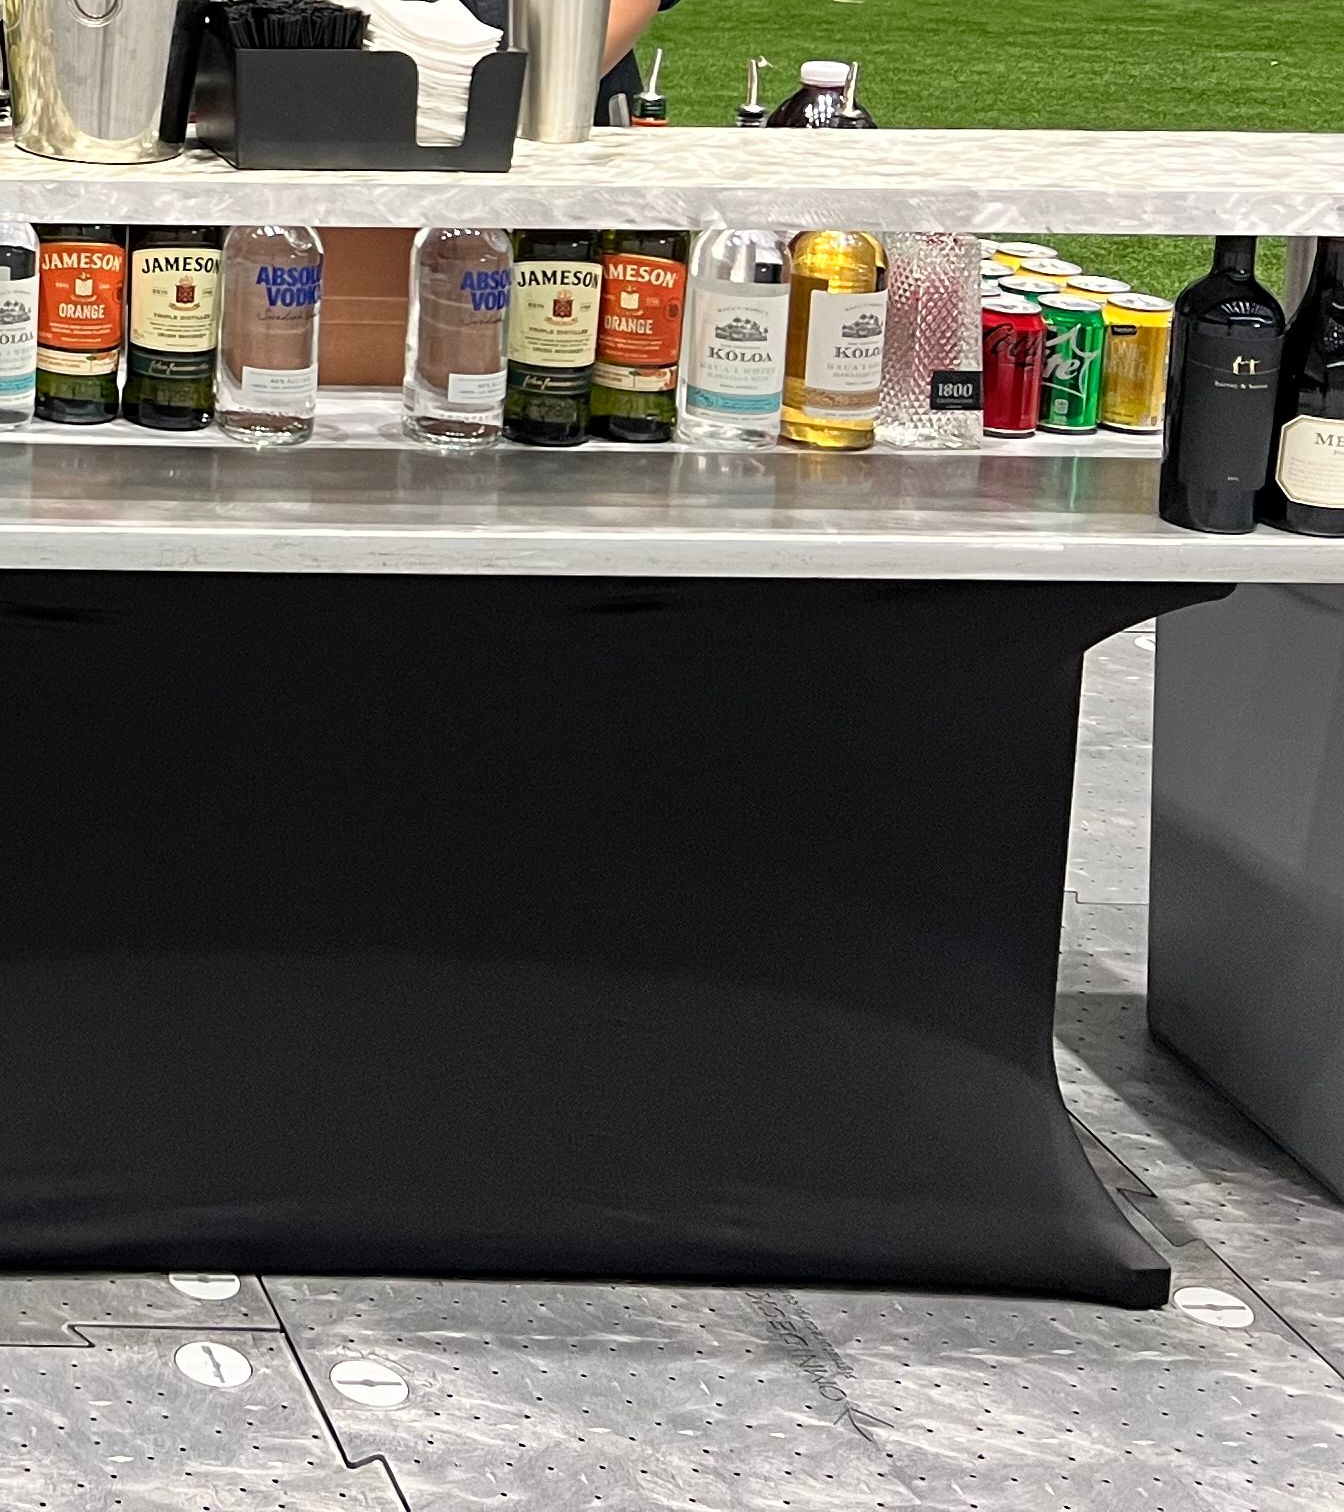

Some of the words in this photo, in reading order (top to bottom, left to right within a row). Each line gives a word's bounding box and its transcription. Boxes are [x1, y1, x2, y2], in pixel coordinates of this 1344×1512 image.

[41, 252, 123, 273] JAMESON
[141, 256, 220, 274] JAMESON
[517, 269, 600, 290] JAMESON
[58, 303, 105, 319] ORANGE
[604, 315, 654, 335] ORANGE
[707, 345, 773, 363] KOLOA
[937, 382, 973, 398] 1800
[745, 1290, 848, 1403] OMNIDECK
